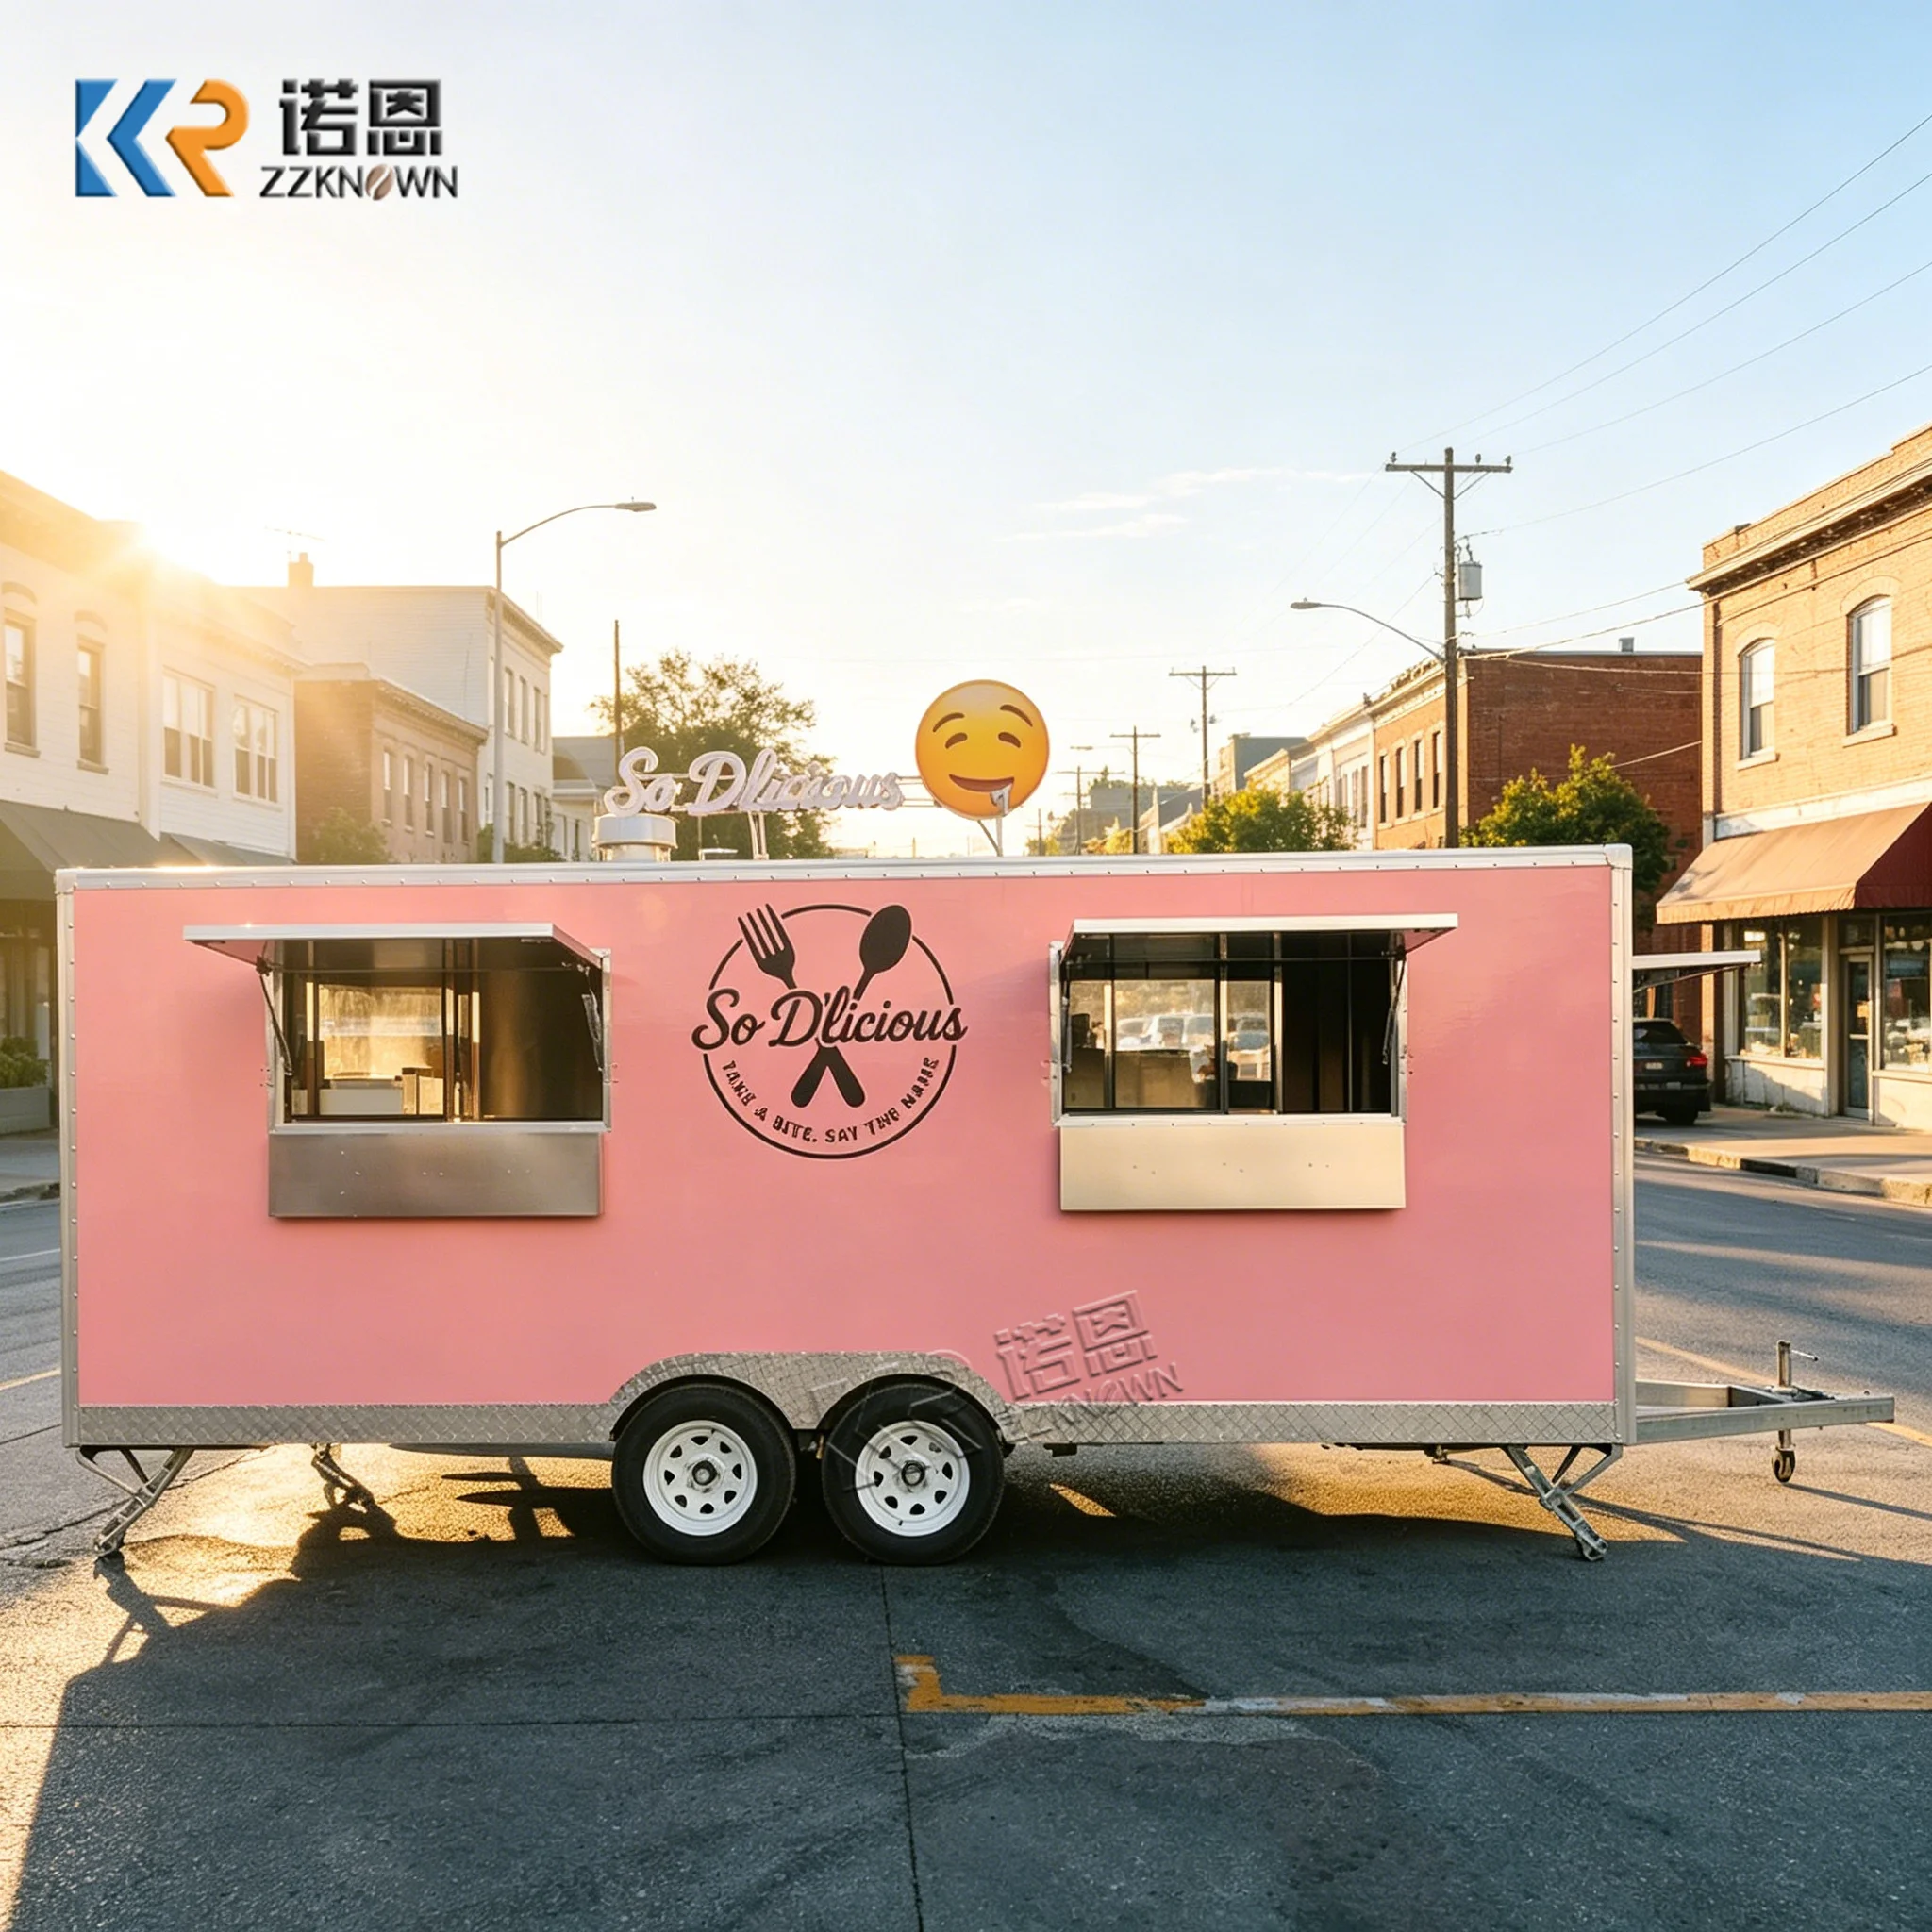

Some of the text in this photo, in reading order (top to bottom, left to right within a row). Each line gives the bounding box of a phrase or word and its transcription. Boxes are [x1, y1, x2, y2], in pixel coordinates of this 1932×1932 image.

[604, 746, 681, 817] So
[691, 985, 969, 1050] So D'licious
[824, 1126, 858, 1143] SAY
